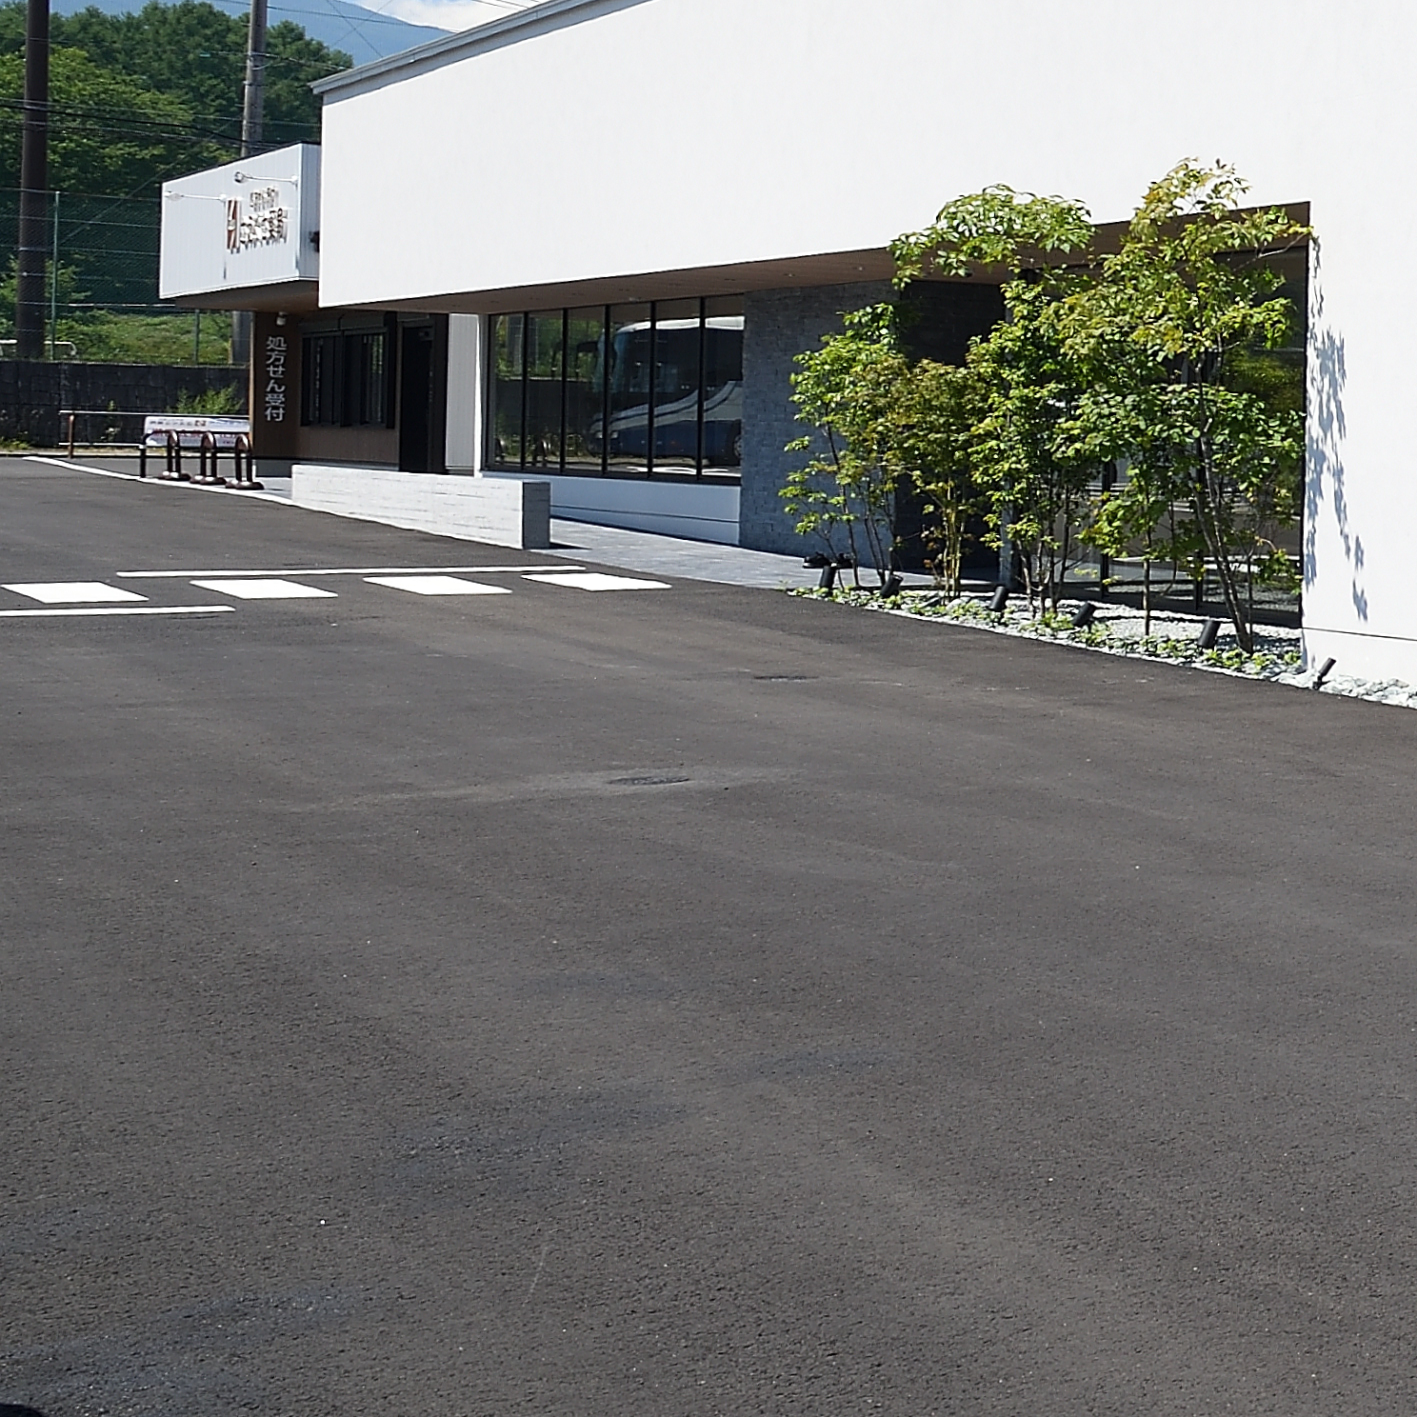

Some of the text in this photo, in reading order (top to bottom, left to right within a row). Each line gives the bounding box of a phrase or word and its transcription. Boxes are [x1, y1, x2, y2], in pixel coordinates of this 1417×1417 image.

[265, 336, 287, 421] 処方せん受付
